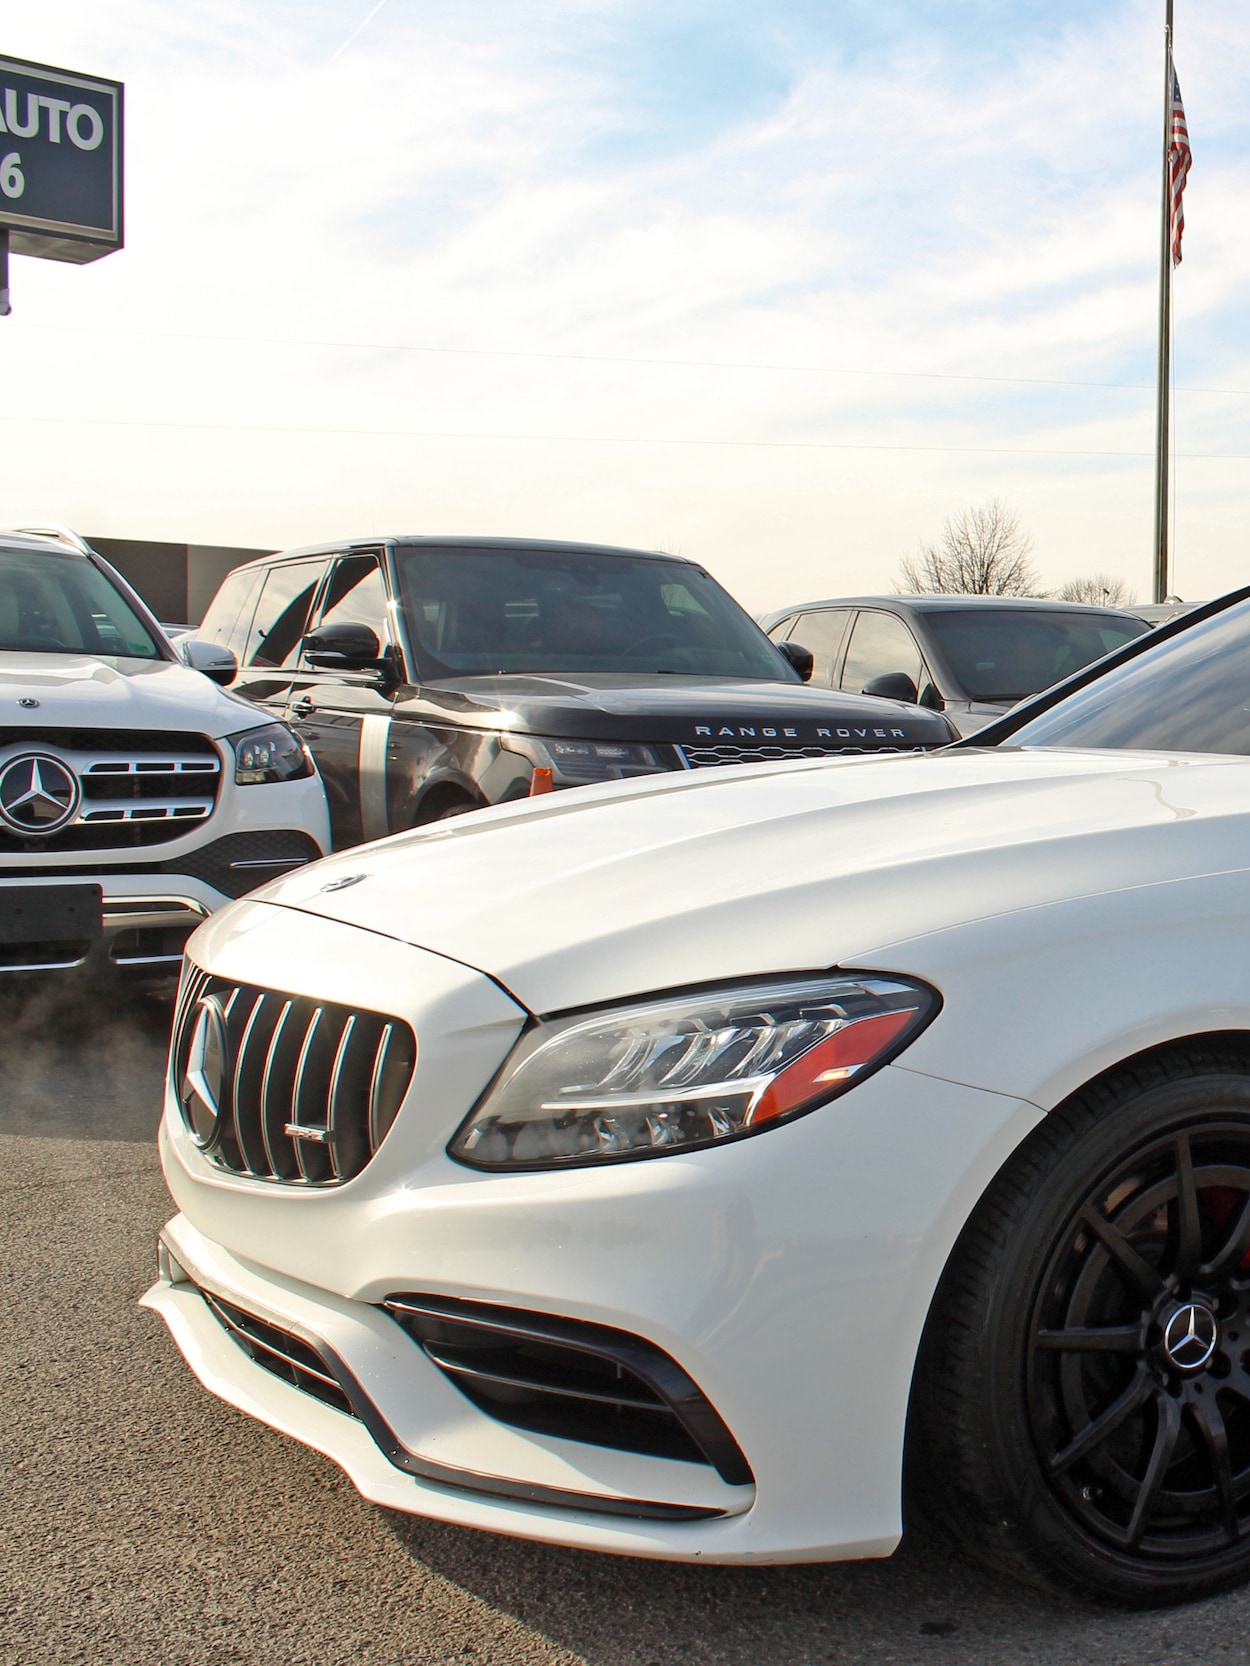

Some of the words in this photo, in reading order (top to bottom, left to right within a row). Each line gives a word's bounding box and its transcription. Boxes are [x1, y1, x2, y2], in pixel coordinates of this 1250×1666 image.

[0, 87, 104, 151] UTO
[694, 725, 798, 737] RANGE
[816, 727, 905, 738] ROVER
